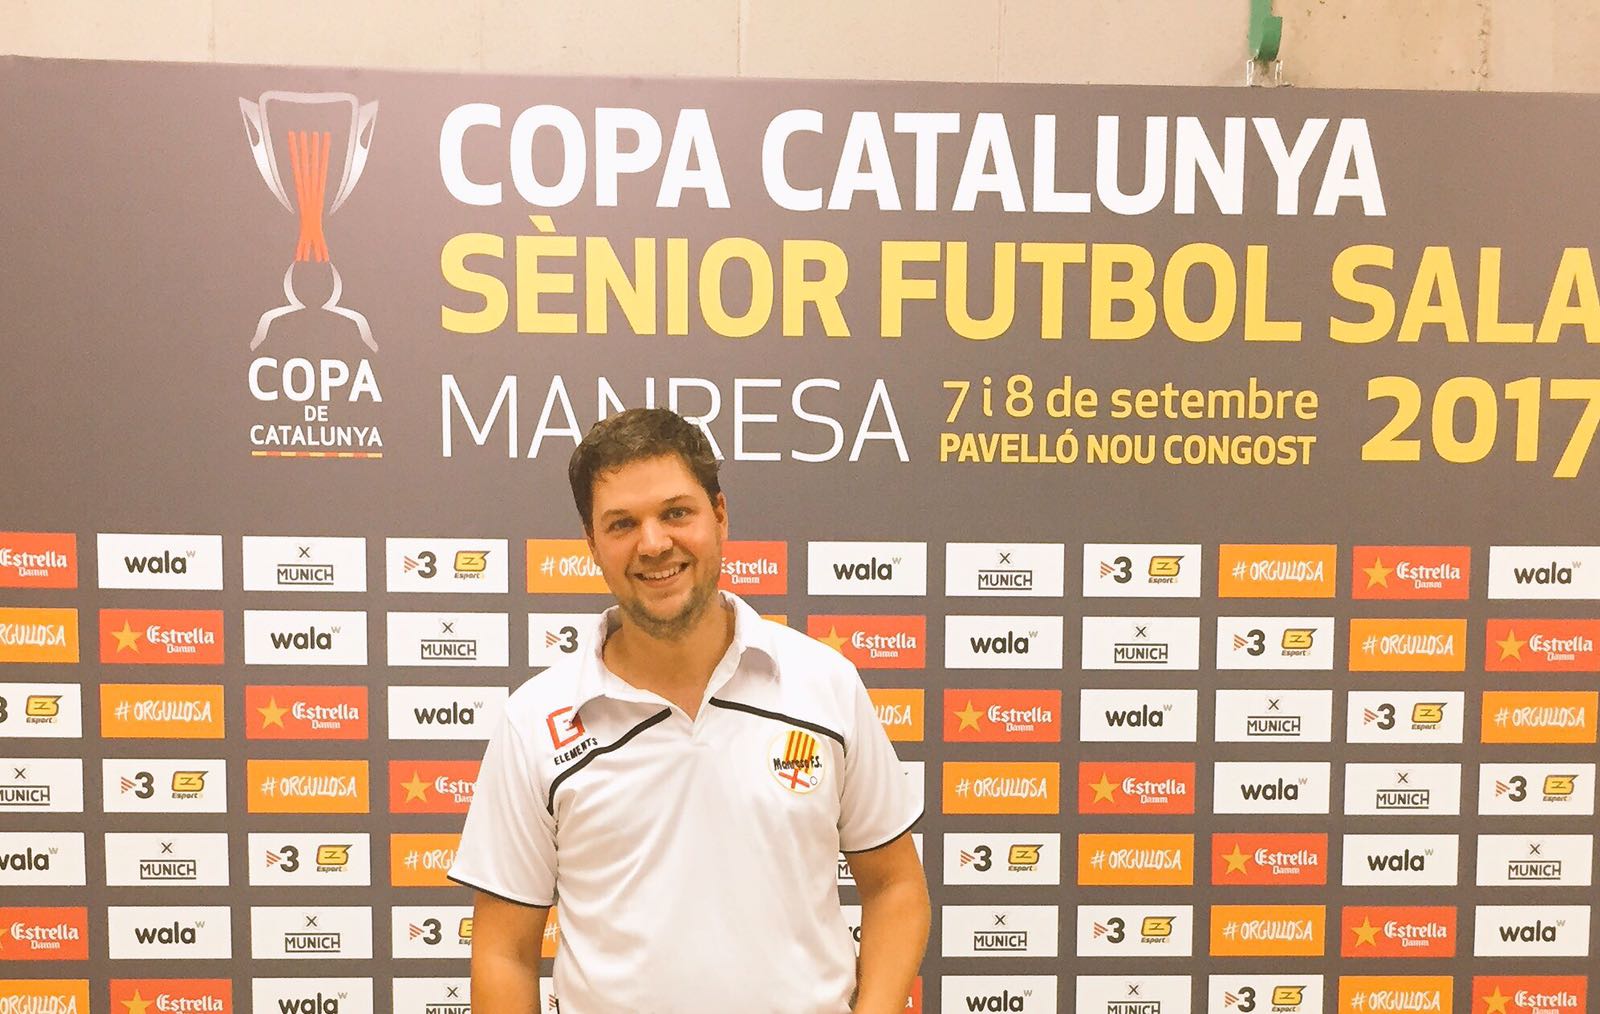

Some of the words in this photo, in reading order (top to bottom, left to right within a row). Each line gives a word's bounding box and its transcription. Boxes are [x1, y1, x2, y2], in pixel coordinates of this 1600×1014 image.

[439, 103, 731, 210] COPA
[762, 111, 1387, 217] CATALUNYA
[440, 216, 850, 338] SÈNIOR
[881, 242, 1303, 343] FUTBOL
[1330, 246, 1600, 345] SALA
[248, 357, 382, 403] COPA
[943, 381, 971, 424] 7
[983, 377, 994, 418] i
[1005, 375, 1035, 419] 8
[1046, 377, 1099, 419] de
[1111, 378, 1320, 421] setembre
[305, 406, 329, 422] DE
[250, 425, 384, 448] CATALUNYA
[1361, 376, 1600, 479] 2017
[940, 429, 1078, 465] PAVELLÓ
[1087, 434, 1157, 465] NOU
[1163, 434, 1318, 466] CONGOST
[0, 548, 68, 569] Estrella
[124, 550, 187, 575] wala
[417, 551, 437, 579] 3
[833, 556, 893, 581] wala
[1113, 556, 1132, 584] 3
[277, 567, 334, 582] MUNICH
[977, 572, 1033, 587] MUNICH
[1249, 559, 1324, 582] ORGULLOSA
[1396, 562, 1461, 582] Estrella
[1513, 561, 1572, 585] wala
[0, 623, 66, 647] RGULLOSA
[146, 625, 215, 646] Estrella
[270, 626, 332, 650] wala
[559, 626, 578, 653] 3
[851, 631, 917, 650] Estrella
[970, 630, 1029, 654] wala
[1247, 629, 1266, 656] 3
[1380, 634, 1453, 656] ORGULLOSA
[1529, 634, 1593, 652] Estrella
[420, 642, 477, 657] MUNICH
[1114, 646, 1169, 660] MUNICH
[133, 700, 212, 722] ORGULLOSA
[292, 702, 360, 722] Estrella
[413, 701, 475, 725] wala
[987, 705, 1052, 723] Estrella
[1105, 704, 1164, 728] wala
[1377, 703, 1396, 730] 3
[1512, 707, 1585, 728] ORGULLOSA
[1246, 719, 1301, 733] MUNICH
[553, 737, 599, 766] ELEMENTS
[135, 771, 155, 799] 3
[279, 775, 357, 798] ORGULLOSA
[973, 777, 1047, 799] ORGULLOSA
[1122, 777, 1186, 795] Estrella
[1240, 777, 1299, 801] wala
[1508, 775, 1527, 802] 3
[1376, 792, 1430, 806] MUNICH
[279, 845, 299, 873] 3
[973, 845, 992, 872] 3
[1108, 849, 1182, 870] ORGULLOSA
[1254, 848, 1318, 866] Estrella
[1367, 848, 1425, 872] wala
[139, 862, 197, 876] MUNICH
[1508, 863, 1562, 877] MUNICH
[10, 922, 79, 940] Estrella
[134, 921, 196, 945] wala
[284, 935, 341, 949] MUNICH
[421, 918, 442, 945] 3
[973, 933, 1028, 947] MUNICH
[1105, 917, 1125, 944] 3
[1240, 920, 1313, 941] ORGULLOSA
[1383, 921, 1447, 940] Estrella
[1499, 919, 1557, 943] wala
[156, 994, 223, 1013] Estrella
[278, 992, 339, 1014] wala
[965, 989, 1024, 1013] wala
[1236, 986, 1256, 1013] 3
[1368, 991, 1441, 1011] ORGULLOSA
[1514, 991, 1577, 1007] Estrella
